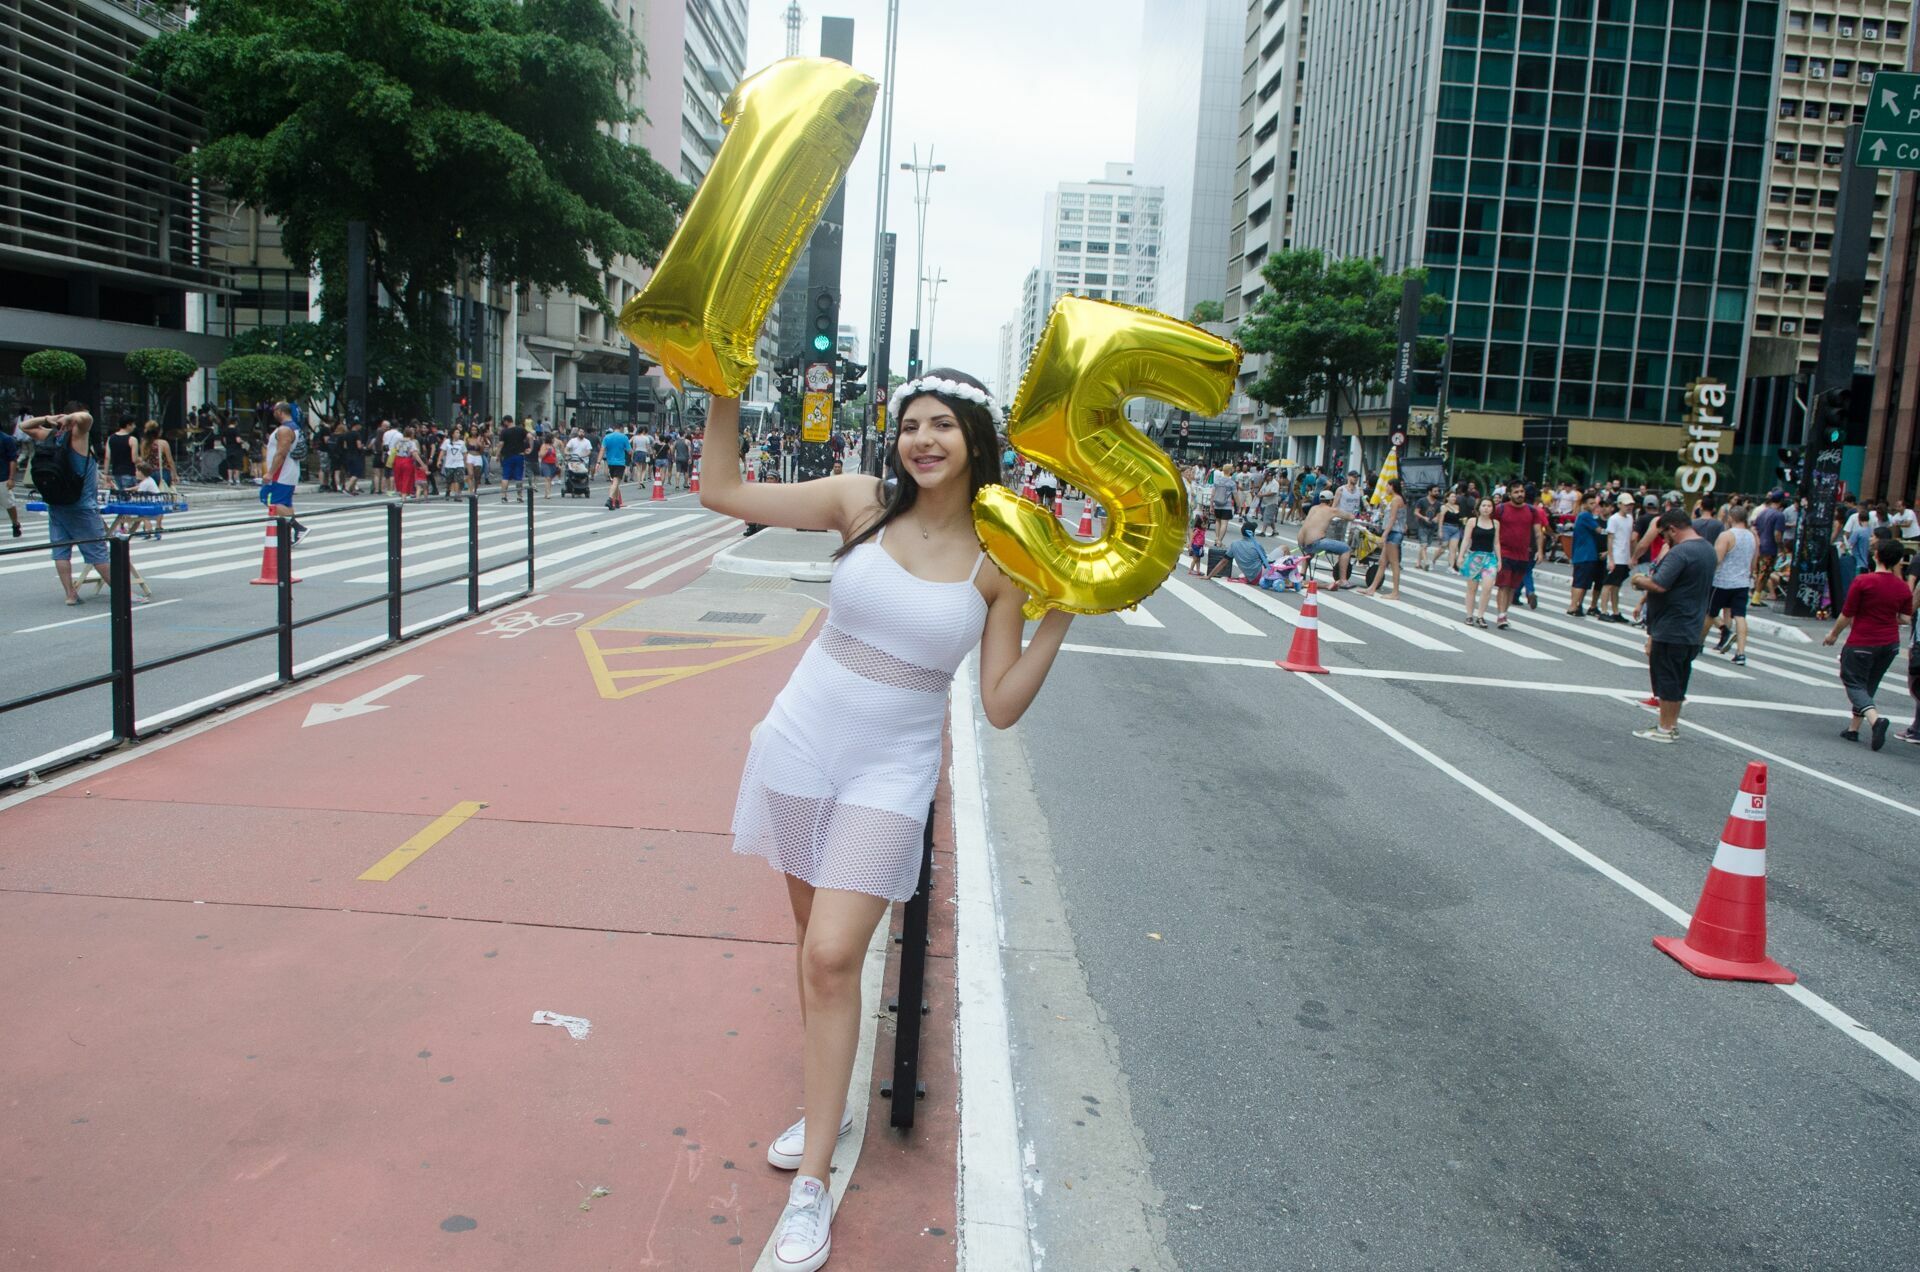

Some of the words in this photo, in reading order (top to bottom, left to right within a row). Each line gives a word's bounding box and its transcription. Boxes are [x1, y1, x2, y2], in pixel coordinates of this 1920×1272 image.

[1398, 341, 1411, 385] Augusta
[973, 294, 1243, 619] 5
[1681, 383, 1727, 495] Safra
